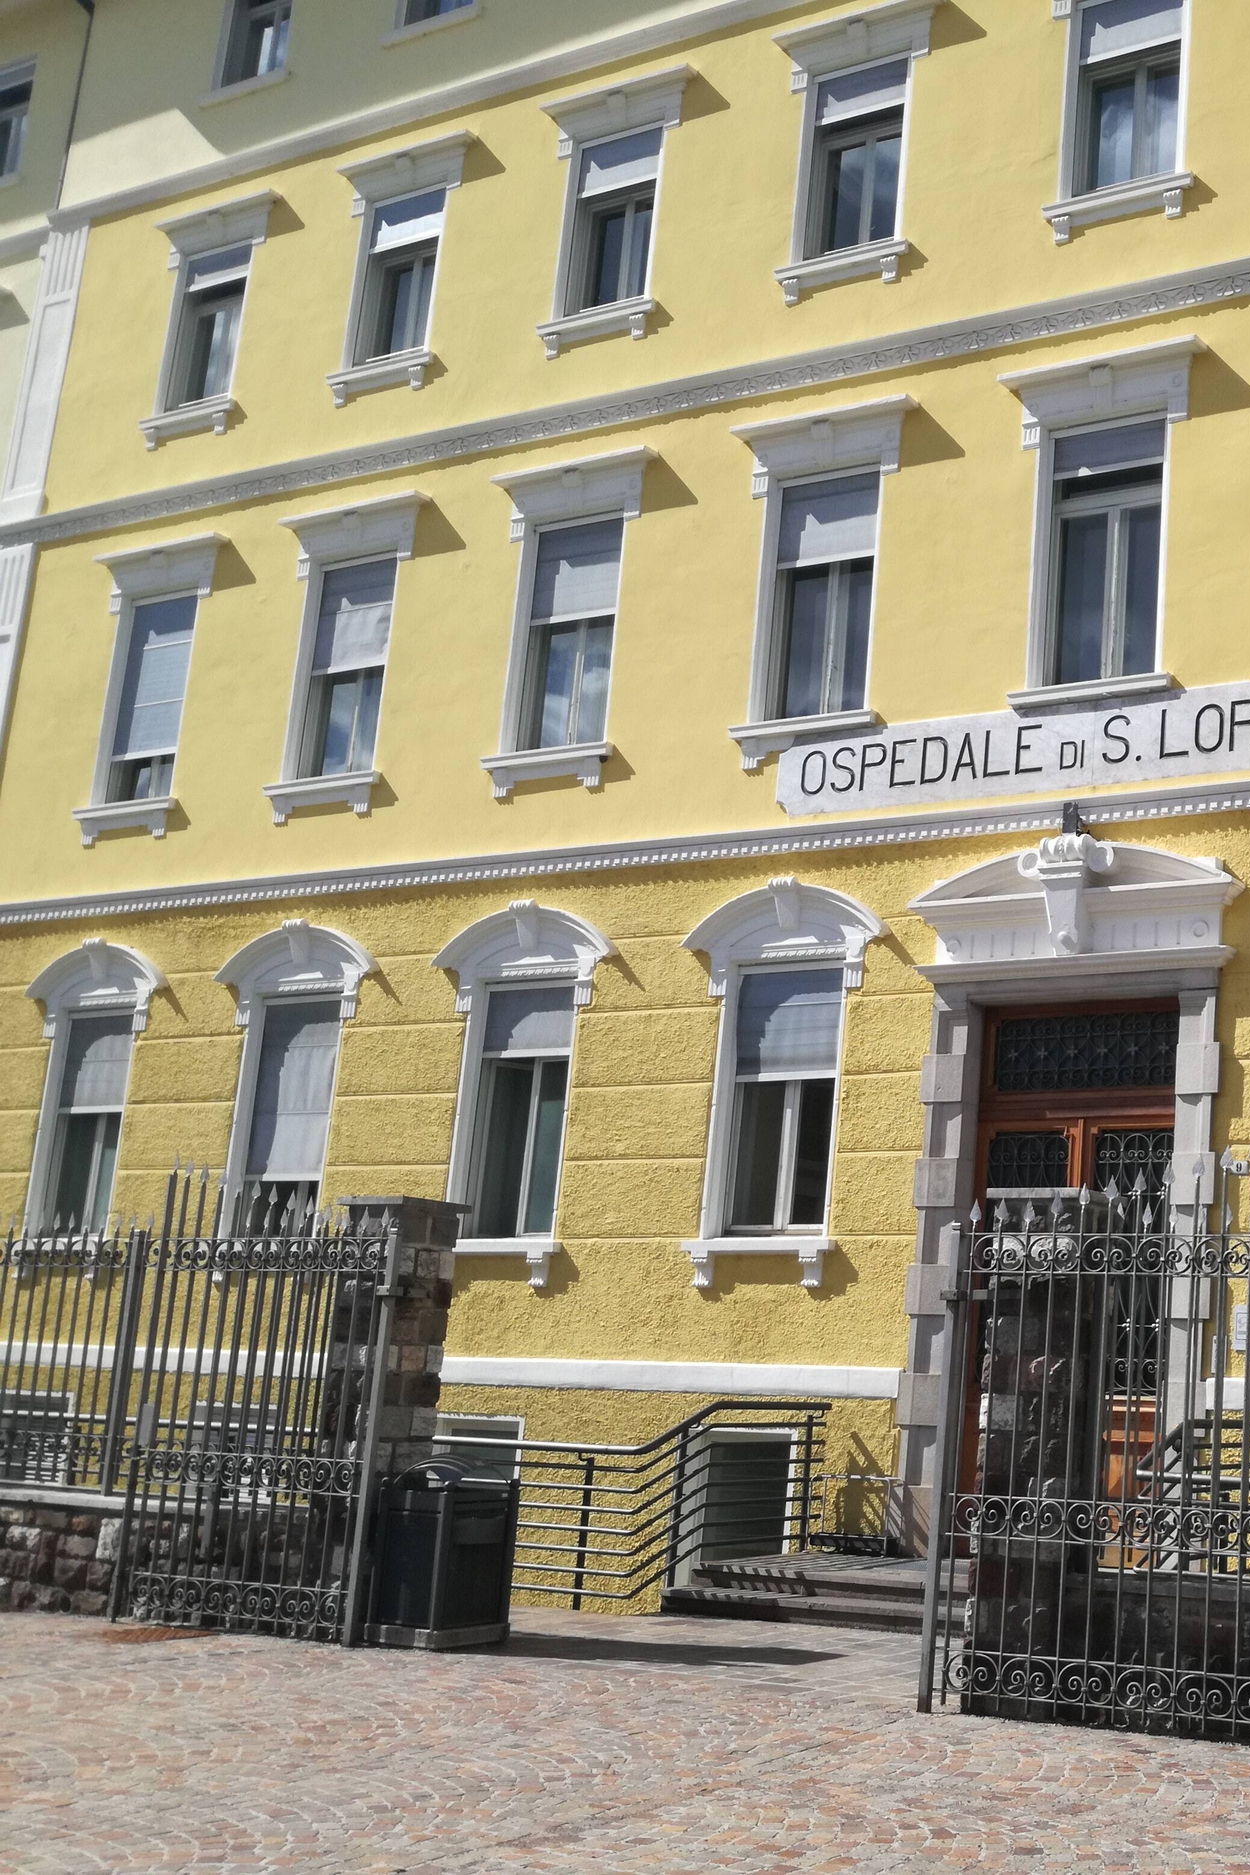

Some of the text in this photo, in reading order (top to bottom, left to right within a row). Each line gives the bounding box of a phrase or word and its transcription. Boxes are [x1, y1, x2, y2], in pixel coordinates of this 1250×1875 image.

[800, 723, 1043, 796] OSPEDALE
[1059, 740, 1085, 770] DI
[1102, 714, 1142, 765] S.
[1236, 1162, 1242, 1172] 9
